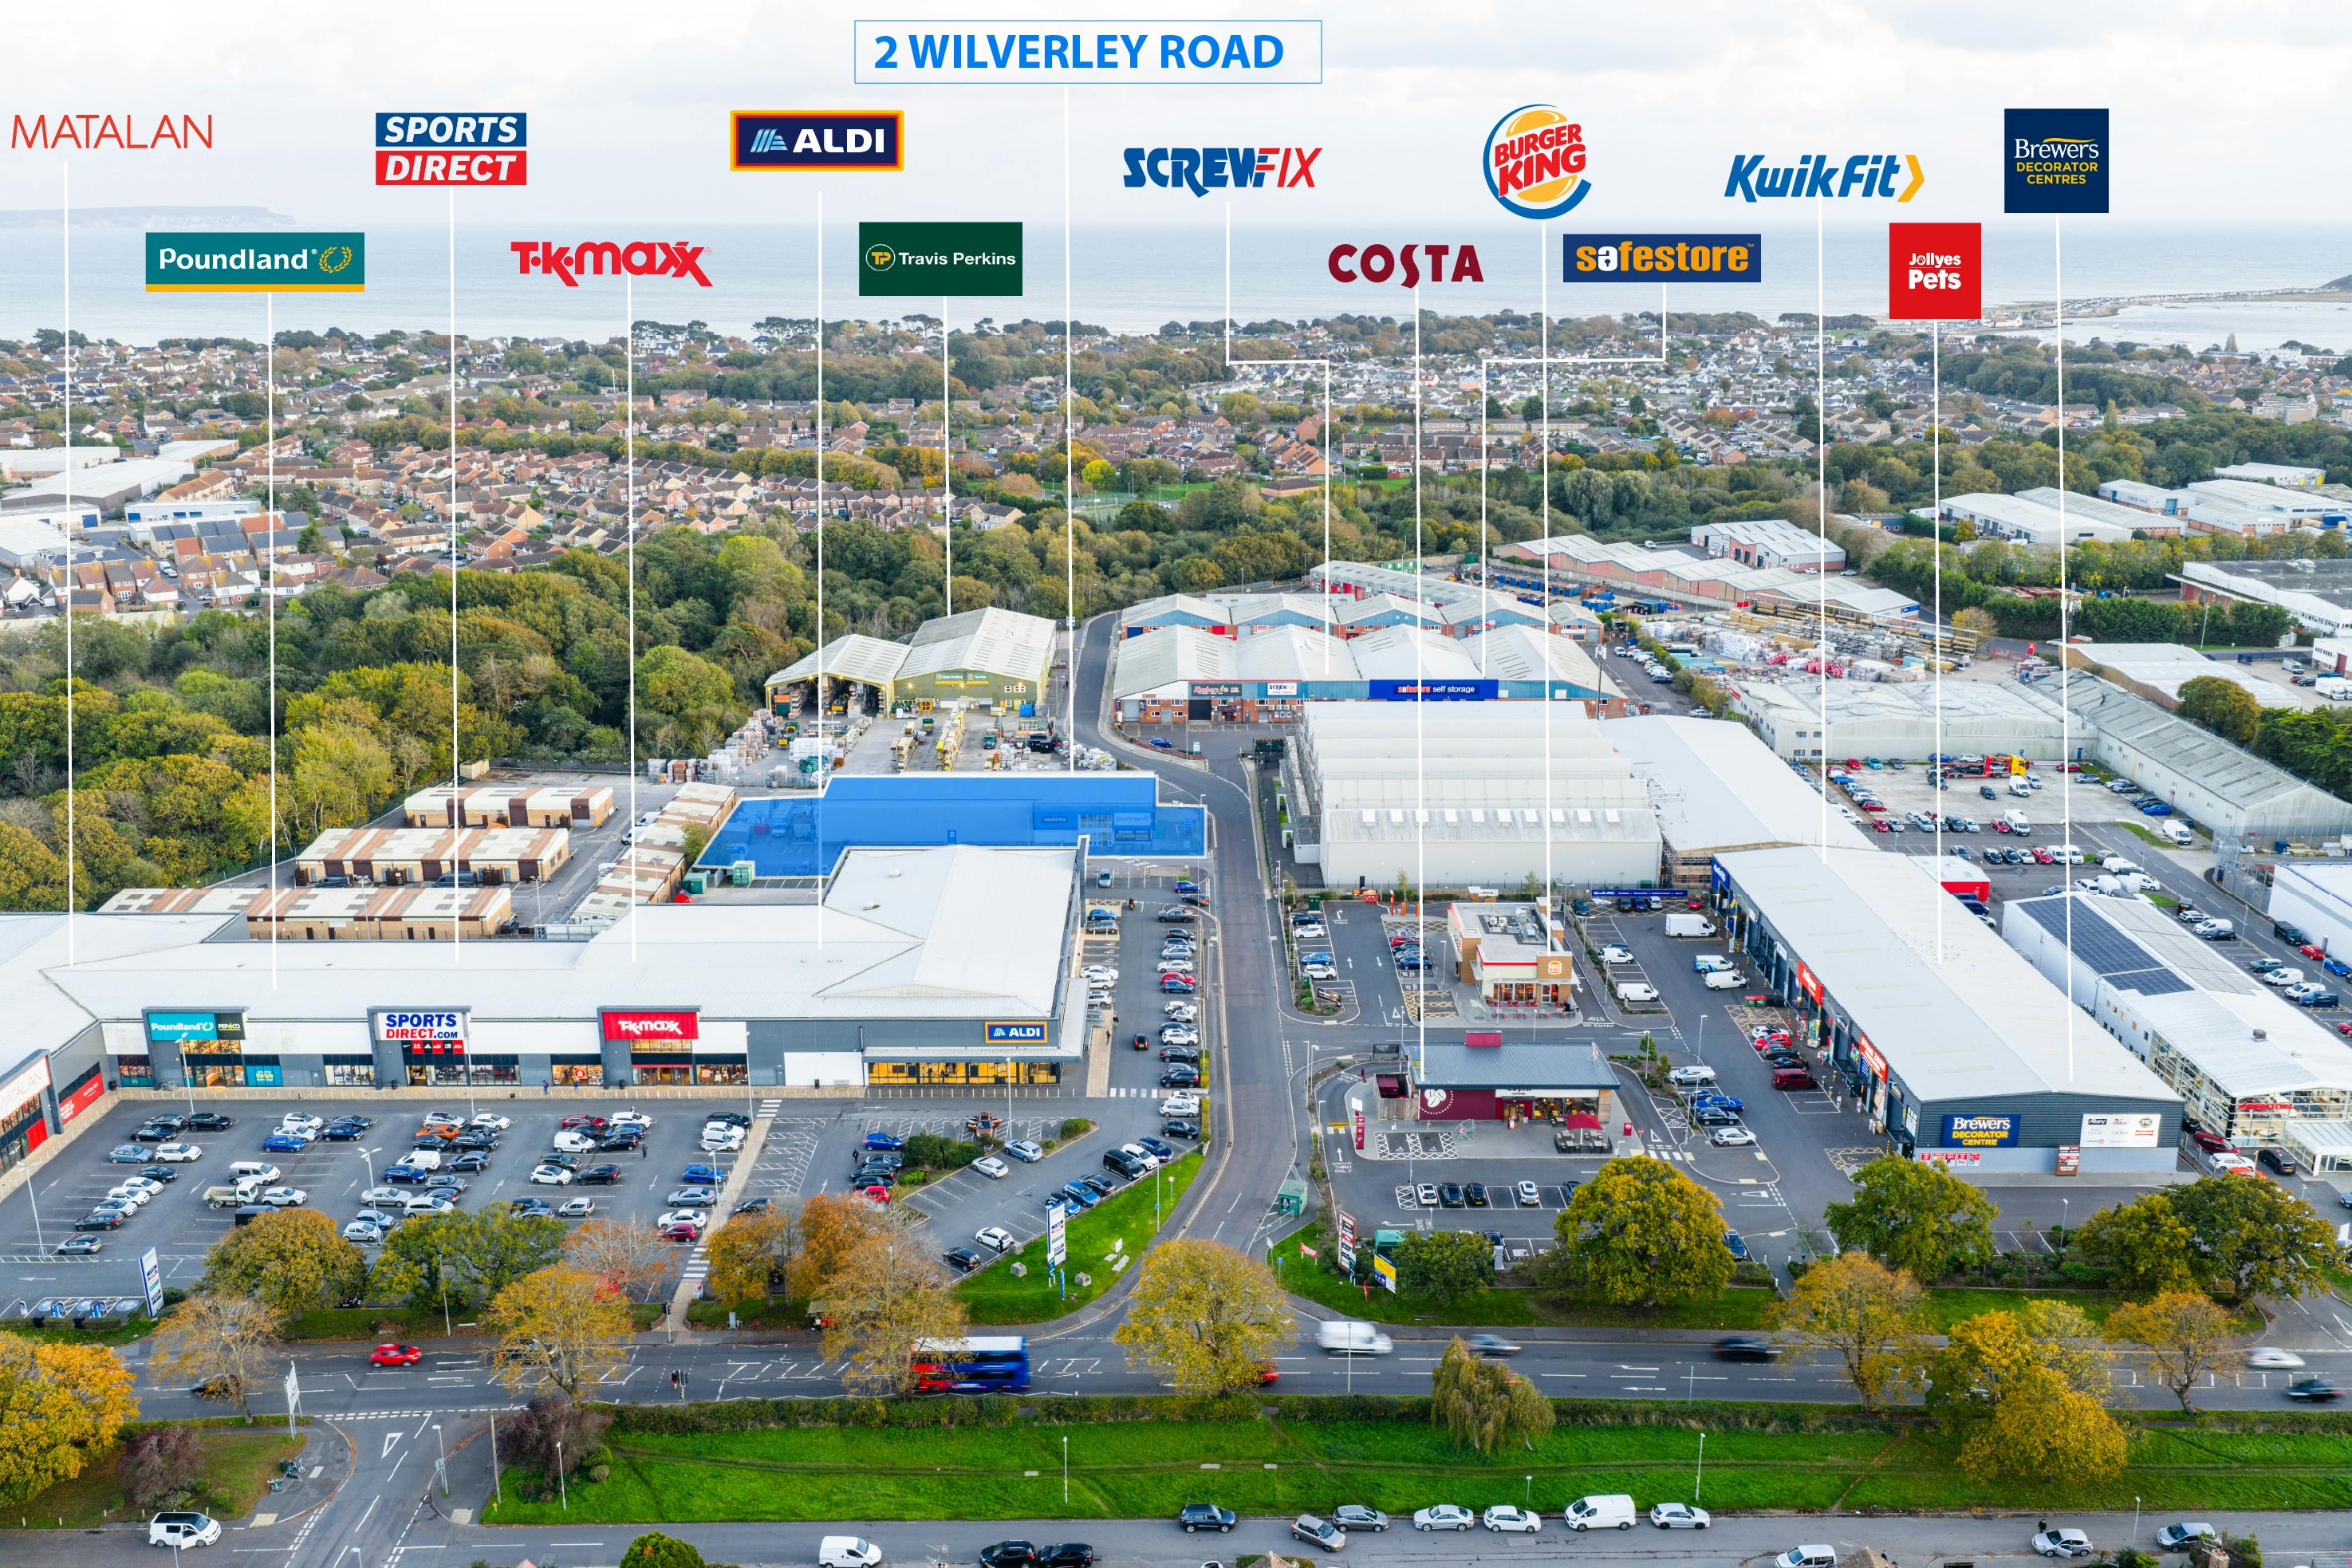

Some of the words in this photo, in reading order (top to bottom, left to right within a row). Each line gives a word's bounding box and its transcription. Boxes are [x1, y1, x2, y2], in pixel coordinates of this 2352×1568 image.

[385, 1014, 457, 1027] SPORTS
[152, 1022, 201, 1031] Poundland
[1009, 1027, 1041, 1037] ALDI
[1952, 1117, 2011, 1130] Brewers
